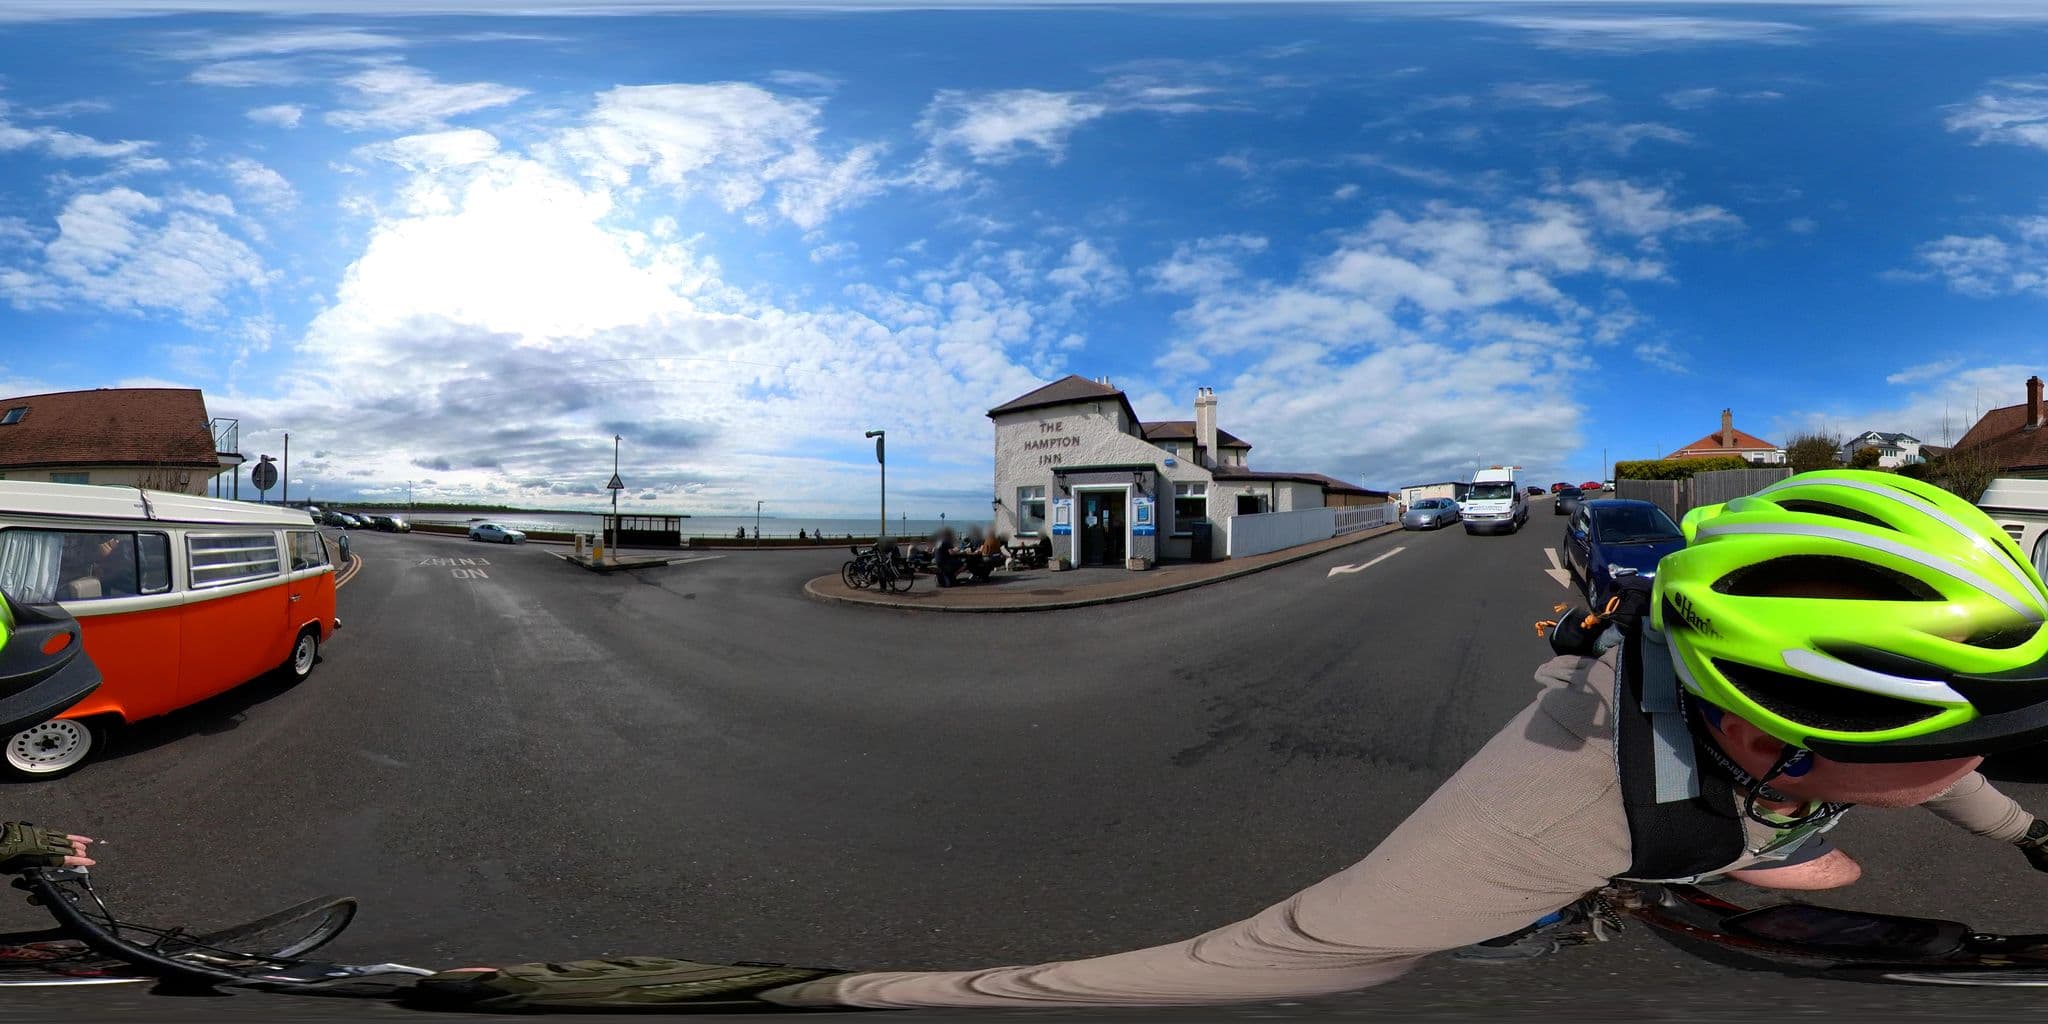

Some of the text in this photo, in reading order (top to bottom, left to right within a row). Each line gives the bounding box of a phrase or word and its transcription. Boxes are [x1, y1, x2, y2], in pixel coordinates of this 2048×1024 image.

[1040, 421, 1063, 433] THE
[1024, 436, 1080, 451] HAMPTON
[1039, 454, 1062, 466] INN
[419, 557, 491, 566] ENTRY
[451, 568, 489, 579] NO
